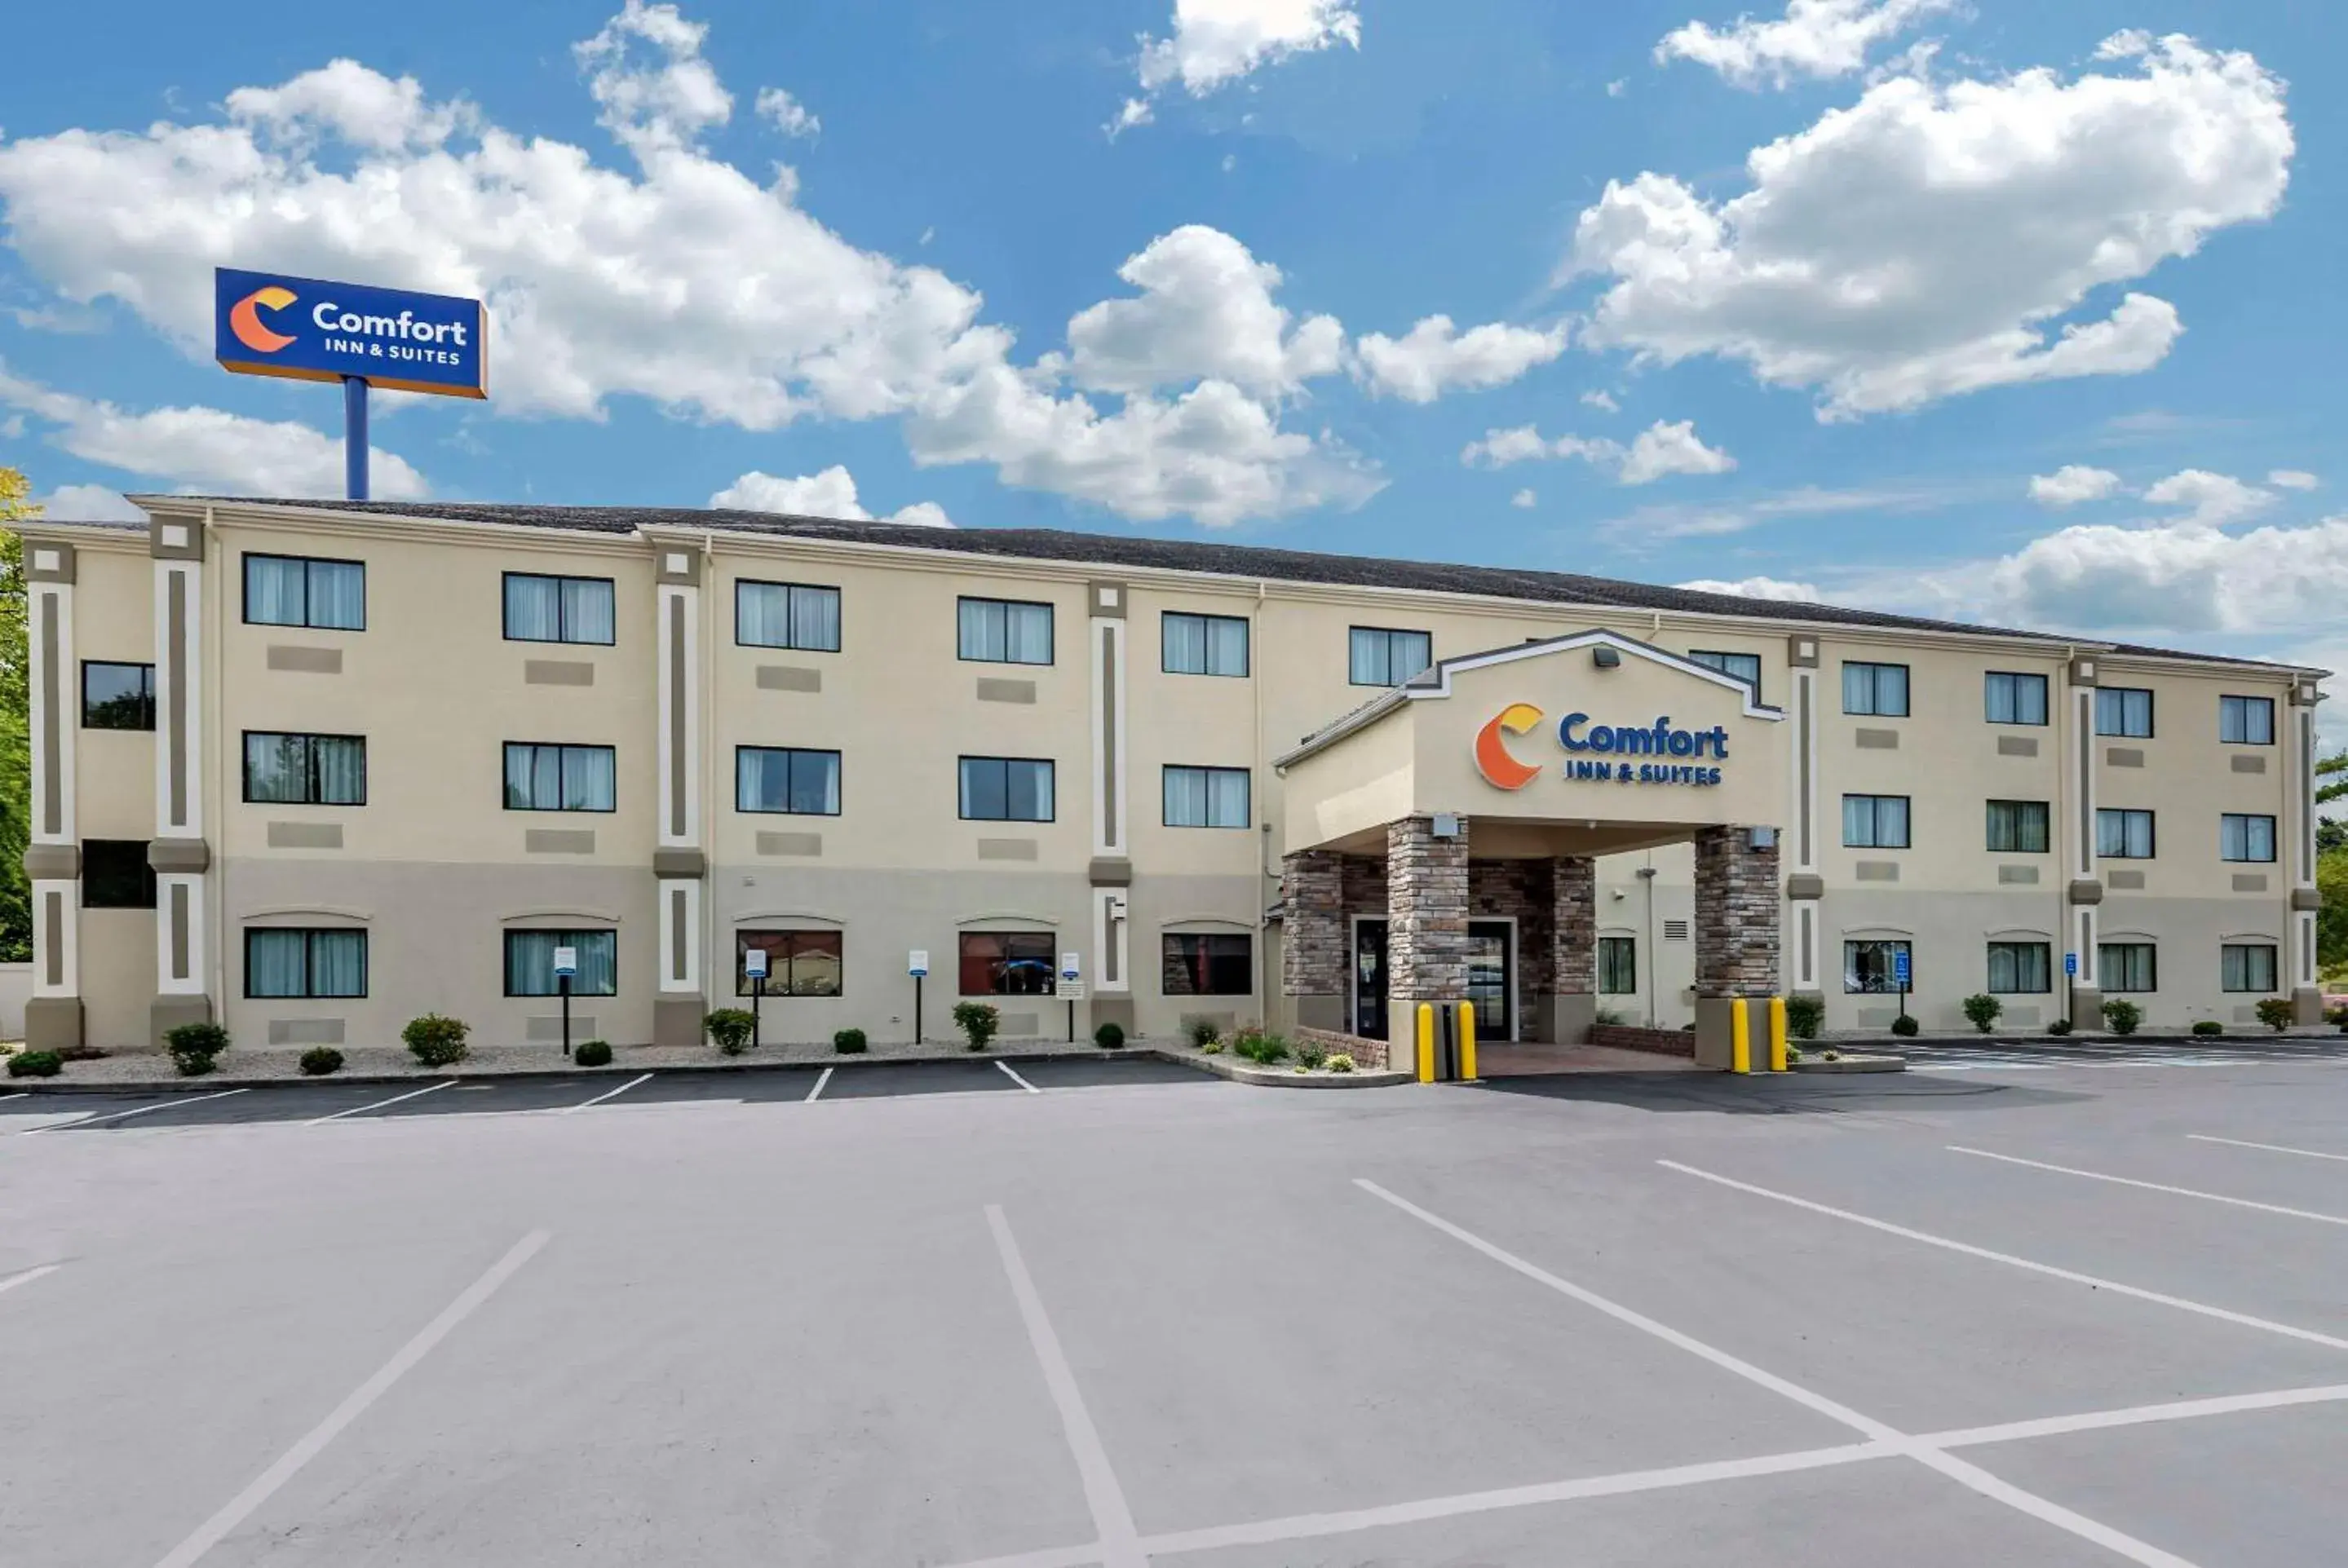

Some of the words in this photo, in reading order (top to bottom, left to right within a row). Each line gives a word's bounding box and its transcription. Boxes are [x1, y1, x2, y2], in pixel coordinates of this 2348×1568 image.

[312, 302, 467, 347] Comfort
[325, 338, 364, 354] INN
[369, 343, 383, 357] &
[388, 345, 460, 366] SUITES
[1559, 712, 1729, 759] Comfort
[1565, 759, 1612, 780] INN
[1617, 762, 1634, 783] &
[1639, 762, 1722, 785] SUITES
